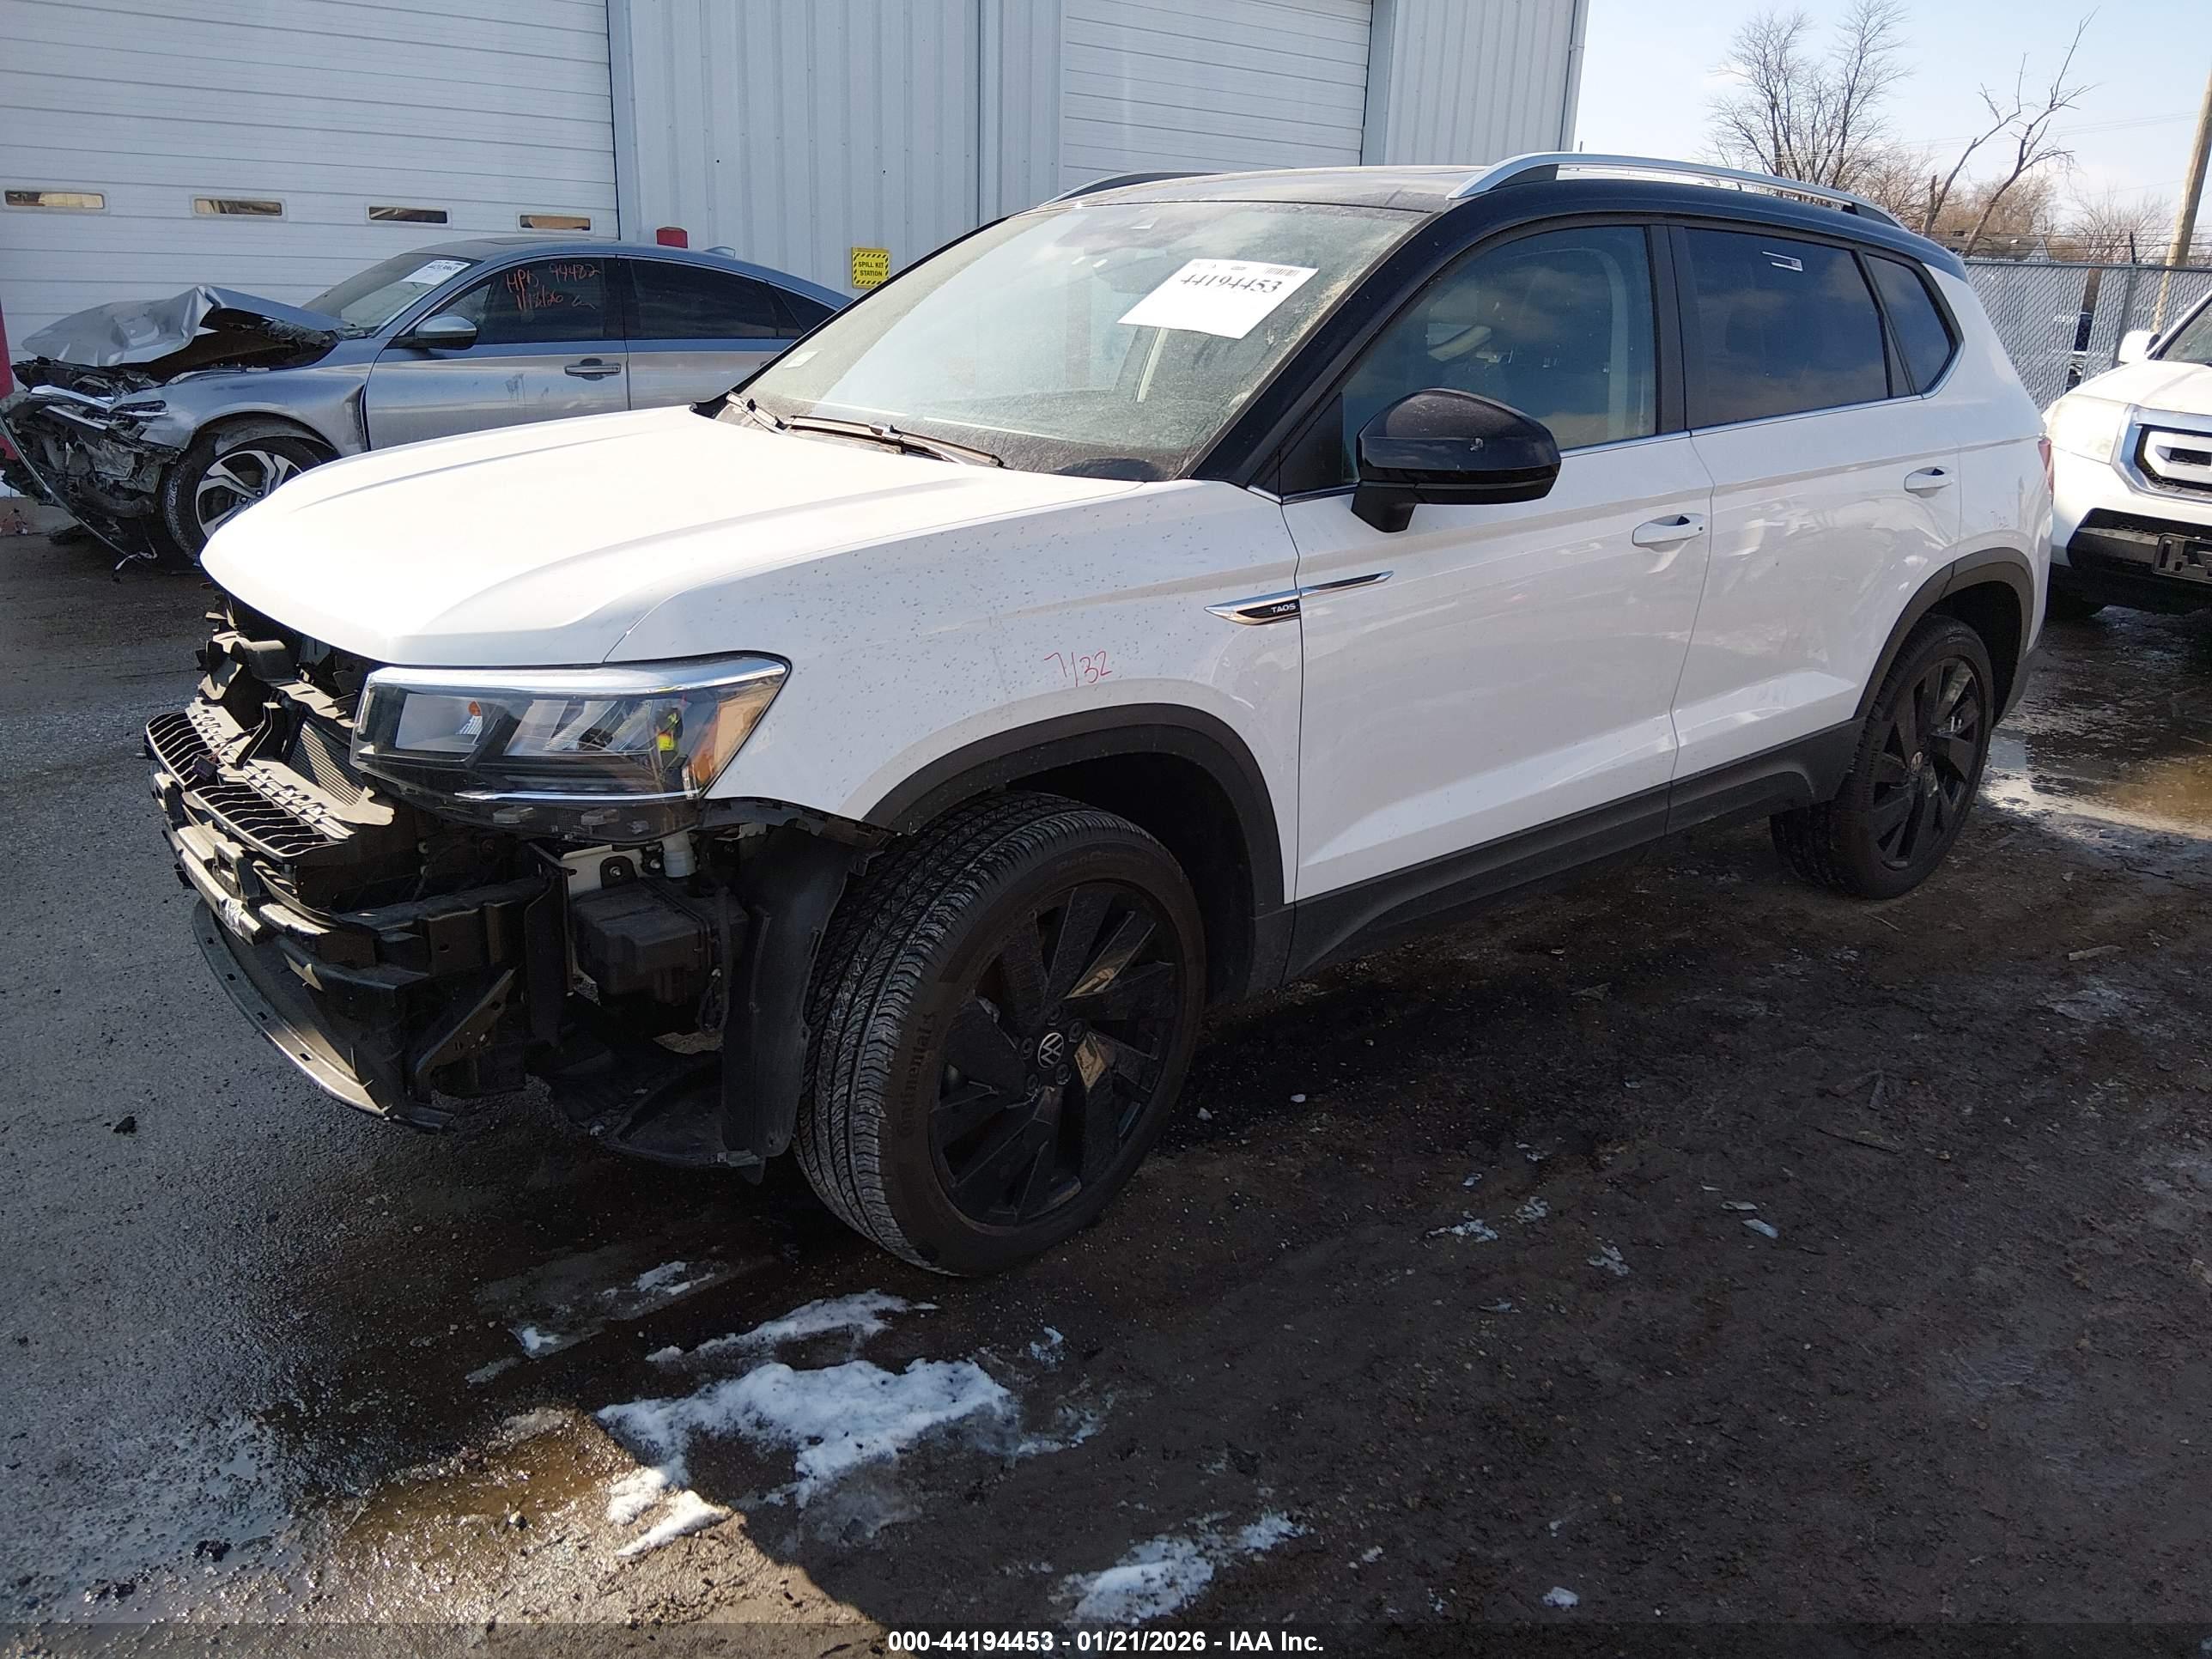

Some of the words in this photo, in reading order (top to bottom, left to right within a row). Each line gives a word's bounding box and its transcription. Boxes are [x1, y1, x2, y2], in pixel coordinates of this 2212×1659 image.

[1180, 273, 1283, 294] 44194453
[1271, 603, 1297, 614] TAOS
[1043, 650, 1113, 688] 7/32
